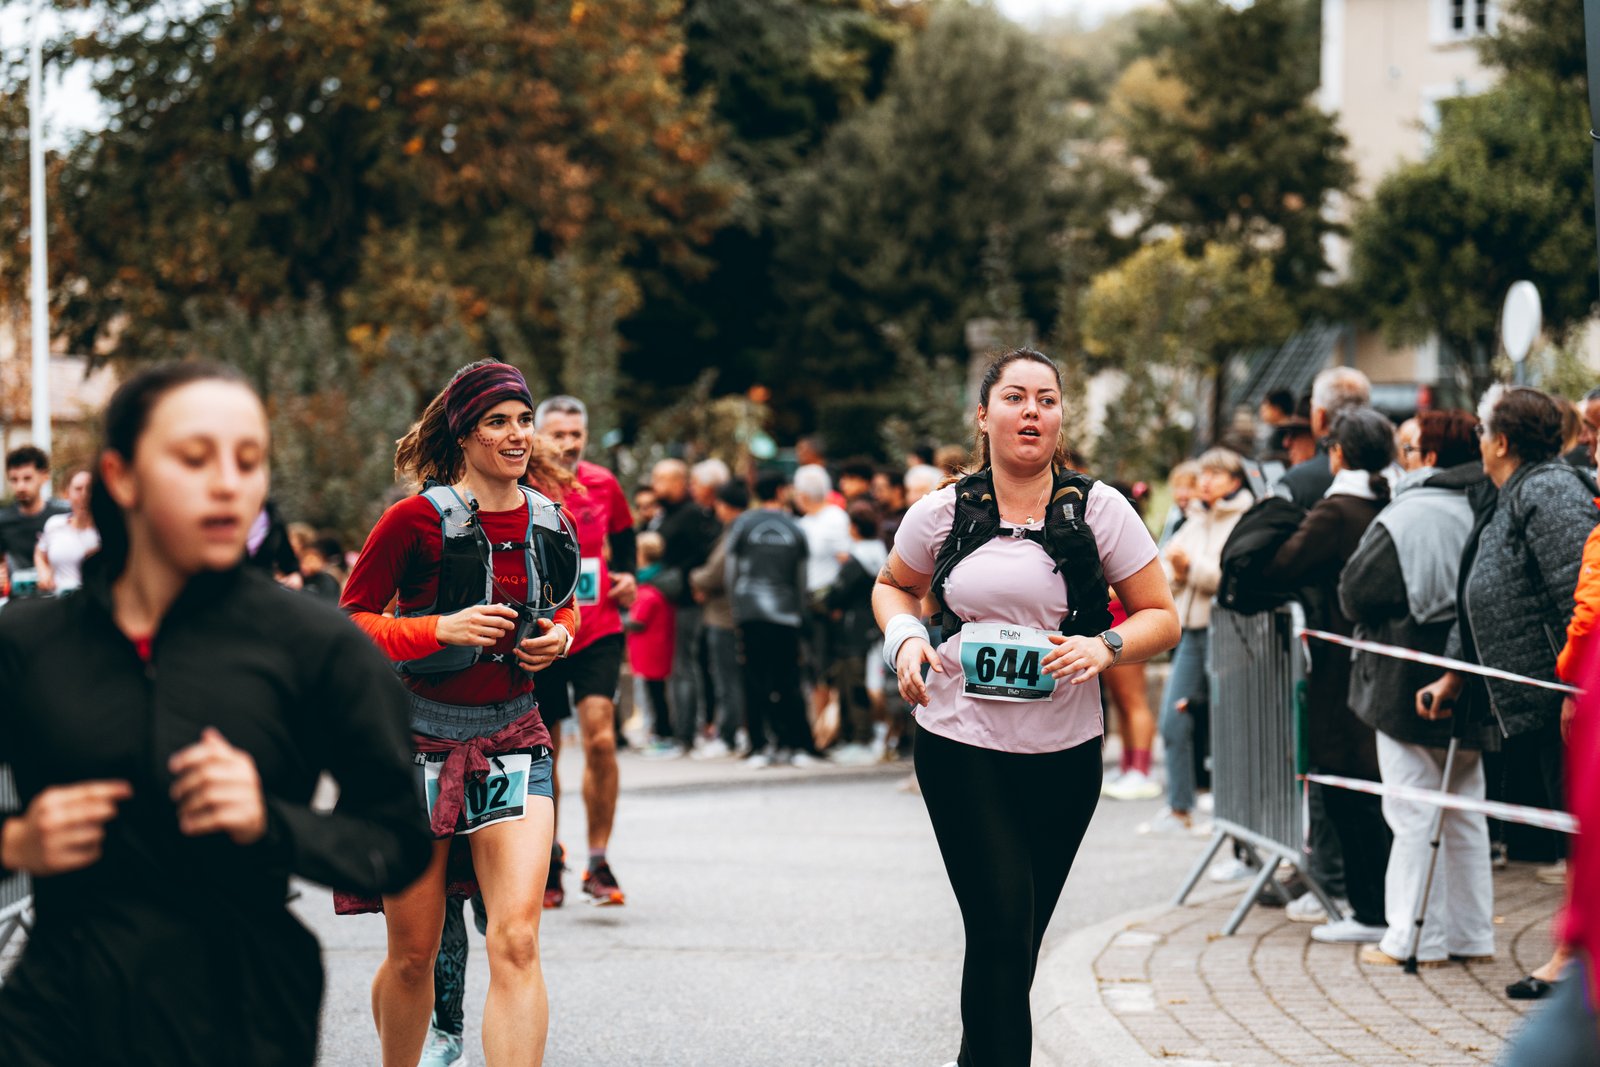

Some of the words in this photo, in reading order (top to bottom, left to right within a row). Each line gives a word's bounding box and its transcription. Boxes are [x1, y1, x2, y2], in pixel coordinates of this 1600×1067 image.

[1000, 629, 1021, 637] RUN
[976, 646, 1040, 687] 644
[467, 777, 510, 815] 02
